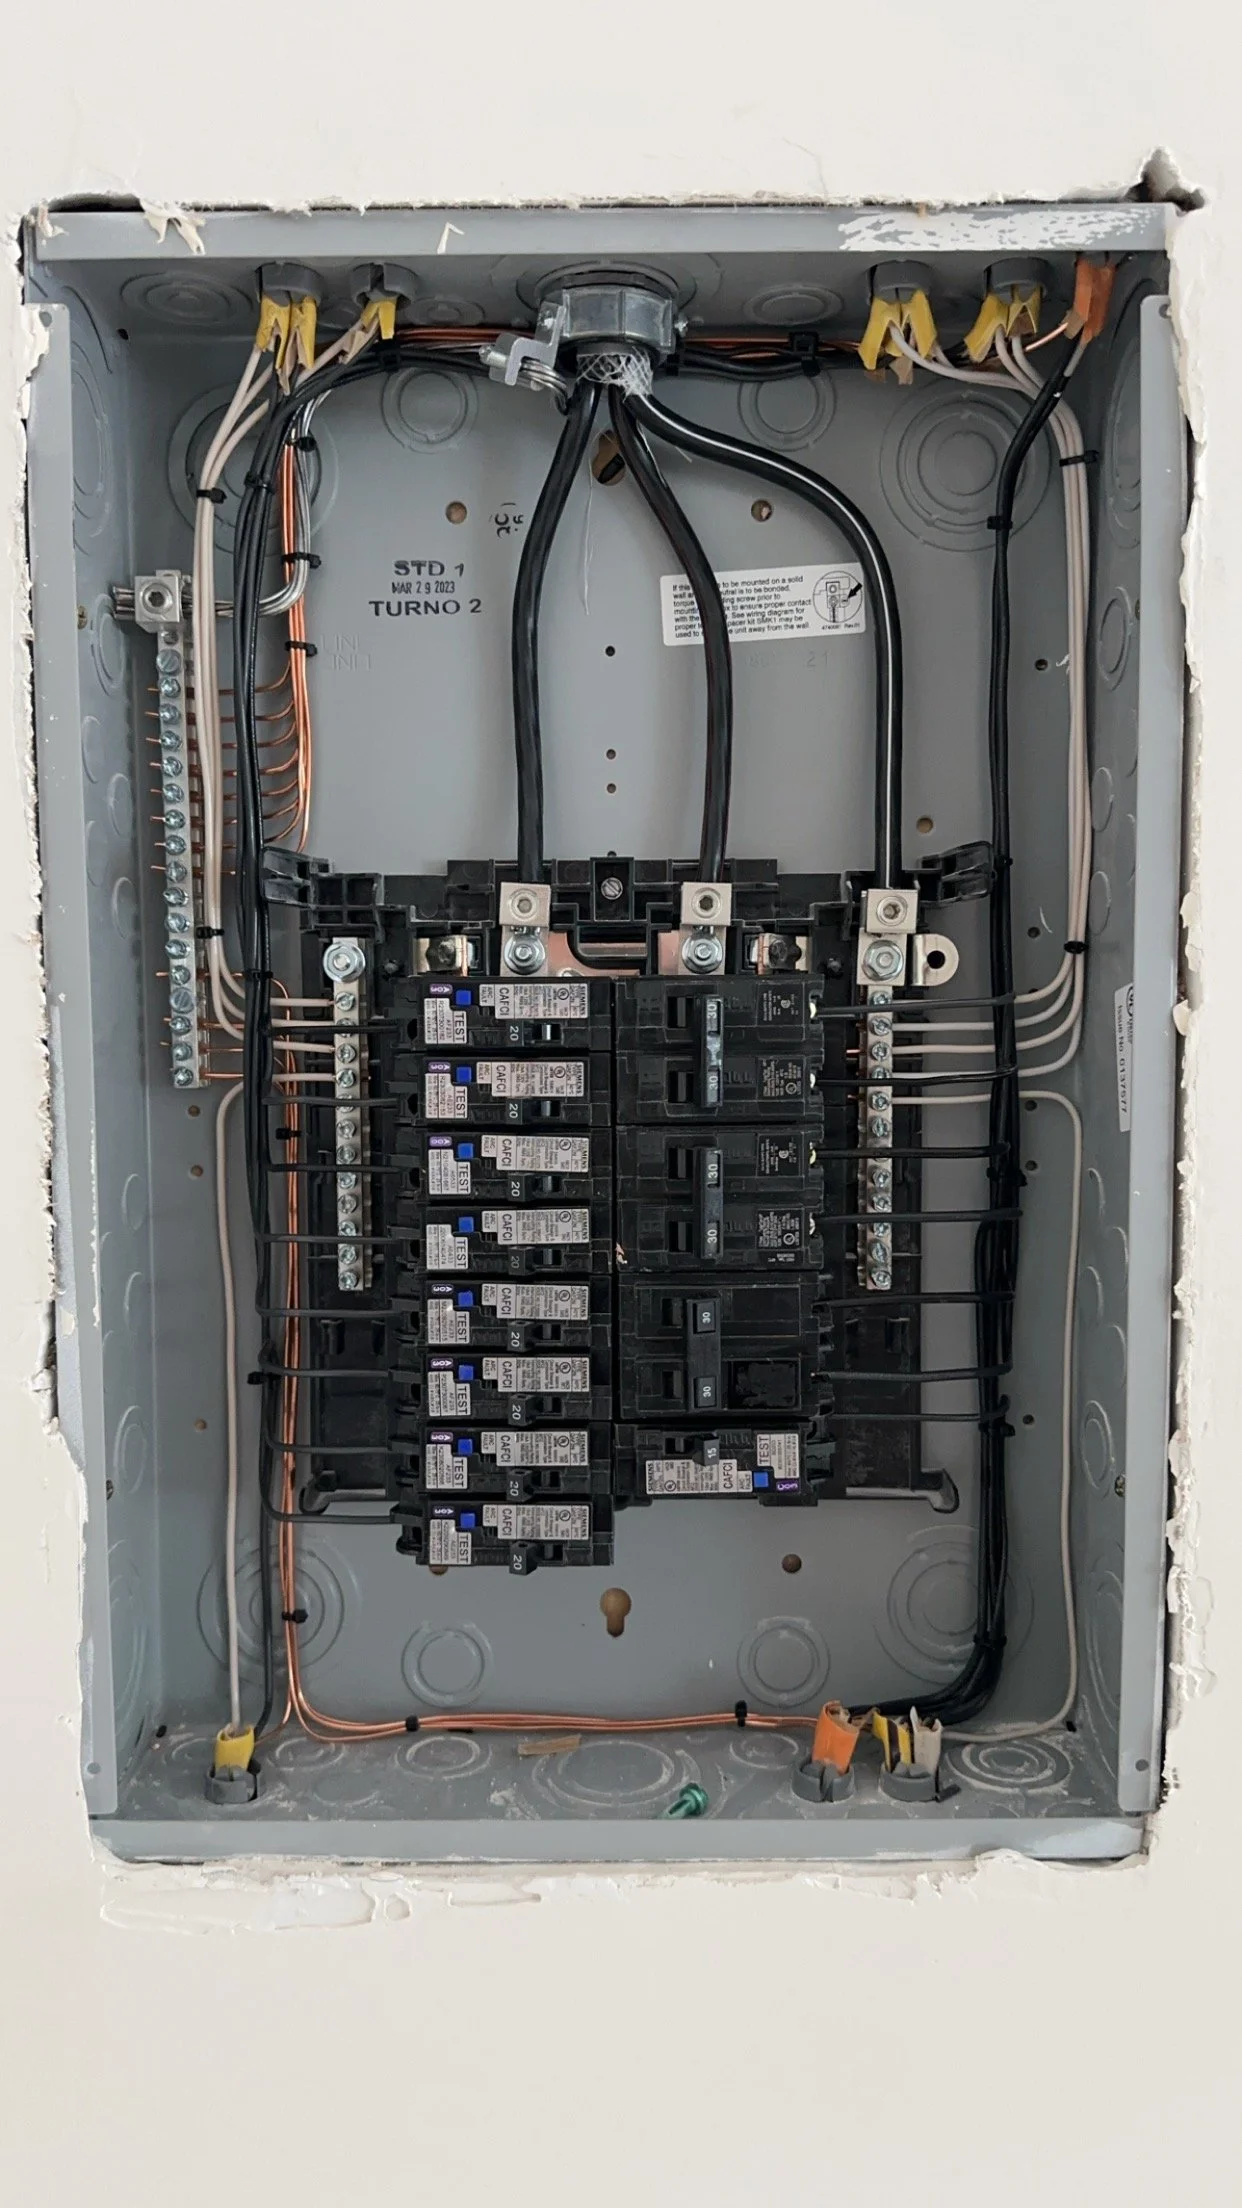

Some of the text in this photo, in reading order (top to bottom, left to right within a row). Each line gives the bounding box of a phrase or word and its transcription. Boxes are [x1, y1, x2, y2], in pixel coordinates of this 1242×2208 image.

[394, 560, 464, 577] STD 1
[392, 582, 412, 594] MAR
[435, 581, 456, 594] 2023
[741, 578, 770, 586] mounted
[368, 598, 482, 617] TURNO 2
[788, 599, 811, 607] contact
[500, 987, 509, 1016] CAFCI
[707, 1003, 717, 1018] 30
[455, 1012, 465, 1042] TEST
[510, 1026, 519, 1042] 20
[496, 1065, 506, 1093] CAFCI
[708, 1075, 718, 1090] 30
[456, 1088, 466, 1118] TEST
[509, 1103, 518, 1119] 20
[502, 1138, 512, 1166] CAFCI
[459, 1165, 469, 1193] TEST
[708, 1163, 718, 1179] 30
[511, 1181, 520, 1197] 20
[502, 1214, 512, 1242] CAFCI
[707, 1229, 717, 1244] 30
[457, 1240, 466, 1268] TEST
[510, 1255, 519, 1269] 20
[501, 1287, 511, 1315] CAFCI
[702, 1312, 711, 1323] 30
[458, 1314, 466, 1342] TEST
[511, 1332, 520, 1347] 20
[502, 1361, 512, 1388] CAFCI
[458, 1387, 467, 1415] TEST
[703, 1386, 711, 1398] 30
[512, 1405, 521, 1420] 20
[500, 1435, 510, 1463] CAFCI
[707, 1448, 716, 1459] 15
[759, 1437, 769, 1464] TEST
[454, 1459, 464, 1487] TEST
[724, 1462, 733, 1489] CAFCI
[510, 1481, 519, 1496] 20
[502, 1508, 512, 1536] CAFCI
[459, 1535, 469, 1563] TEST
[513, 1555, 522, 1570] 20
